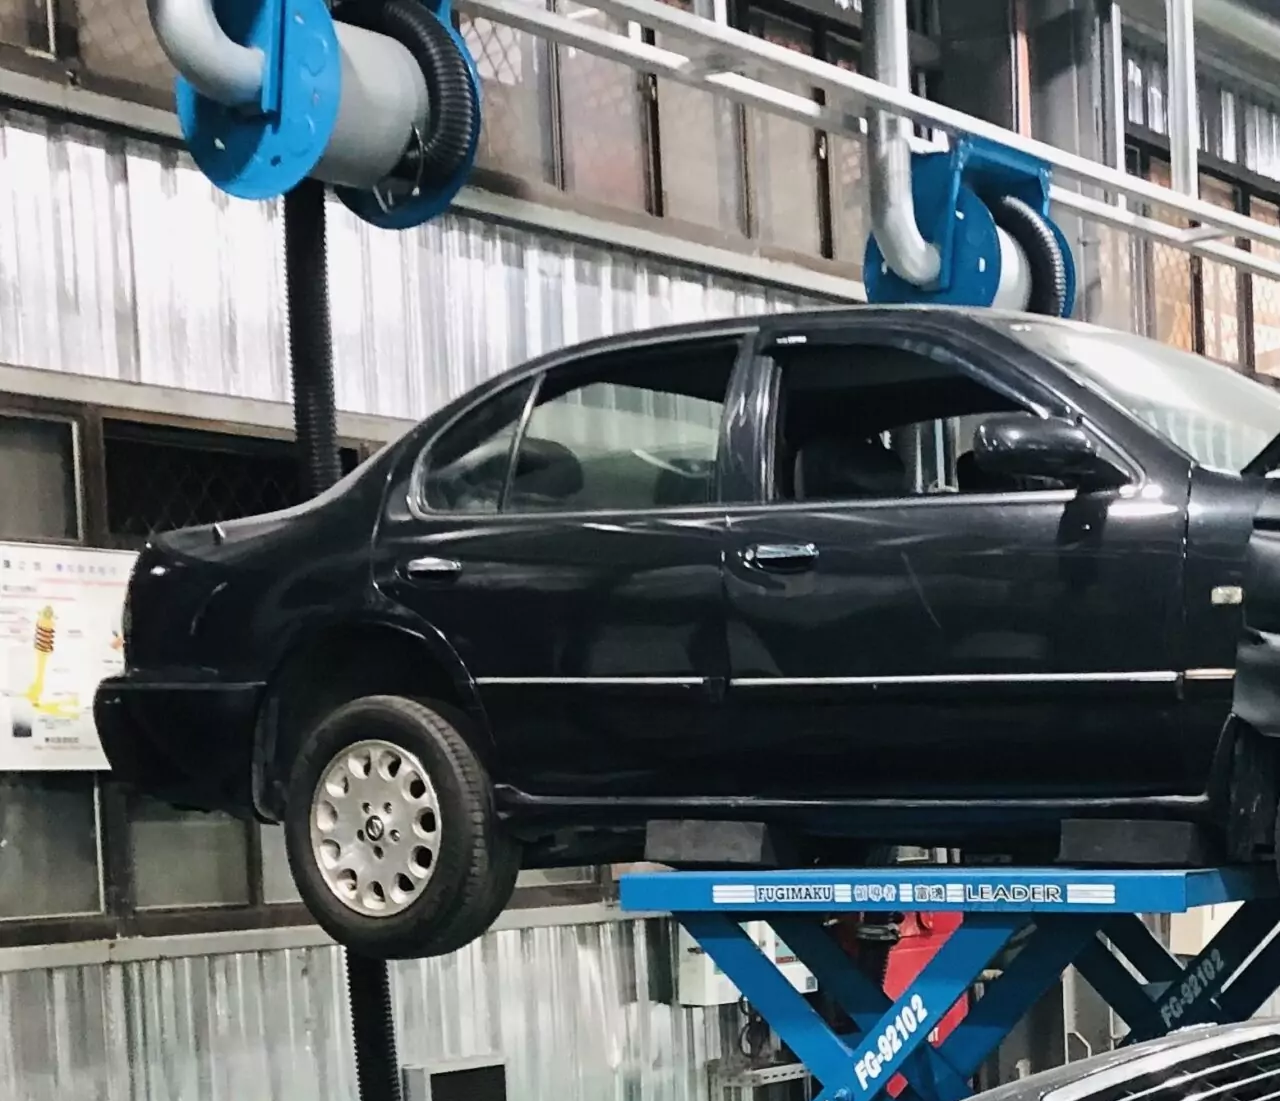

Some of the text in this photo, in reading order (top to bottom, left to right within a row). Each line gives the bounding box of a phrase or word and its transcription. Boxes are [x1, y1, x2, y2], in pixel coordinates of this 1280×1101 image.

[757, 886, 833, 901] FUGIMAKU
[966, 885, 1063, 902] LEADER
[1160, 948, 1225, 1029] FG-92102
[854, 993, 928, 1091] FG-92102
